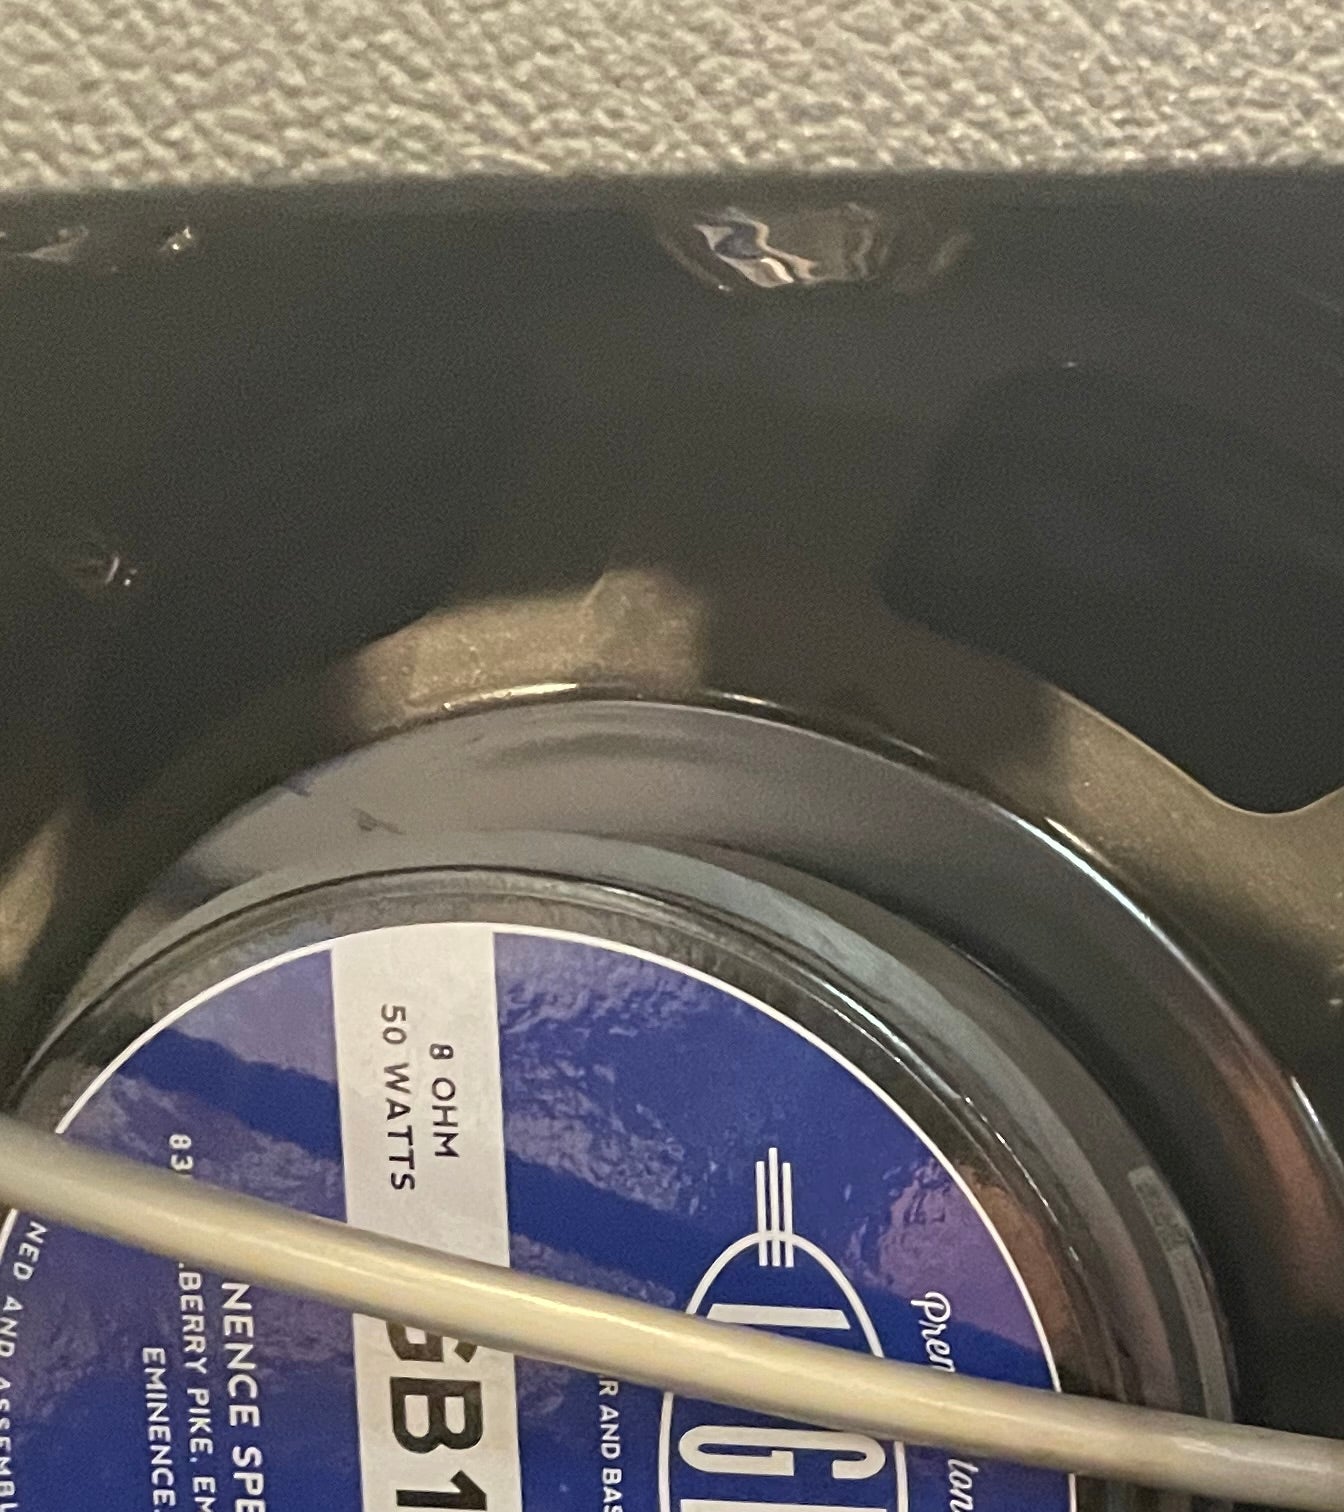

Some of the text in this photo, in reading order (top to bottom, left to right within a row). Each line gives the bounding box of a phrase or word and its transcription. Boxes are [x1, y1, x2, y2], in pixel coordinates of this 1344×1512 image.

[380, 1003, 416, 1190] 50 WATTS
[429, 1043, 460, 1158] 8 OHM
[168, 1134, 195, 1171] 83
[0, 1295, 24, 1358] AND
[178, 1270, 207, 1374] BERRY
[221, 1282, 261, 1428] NENCE
[599, 1405, 621, 1460] AND
